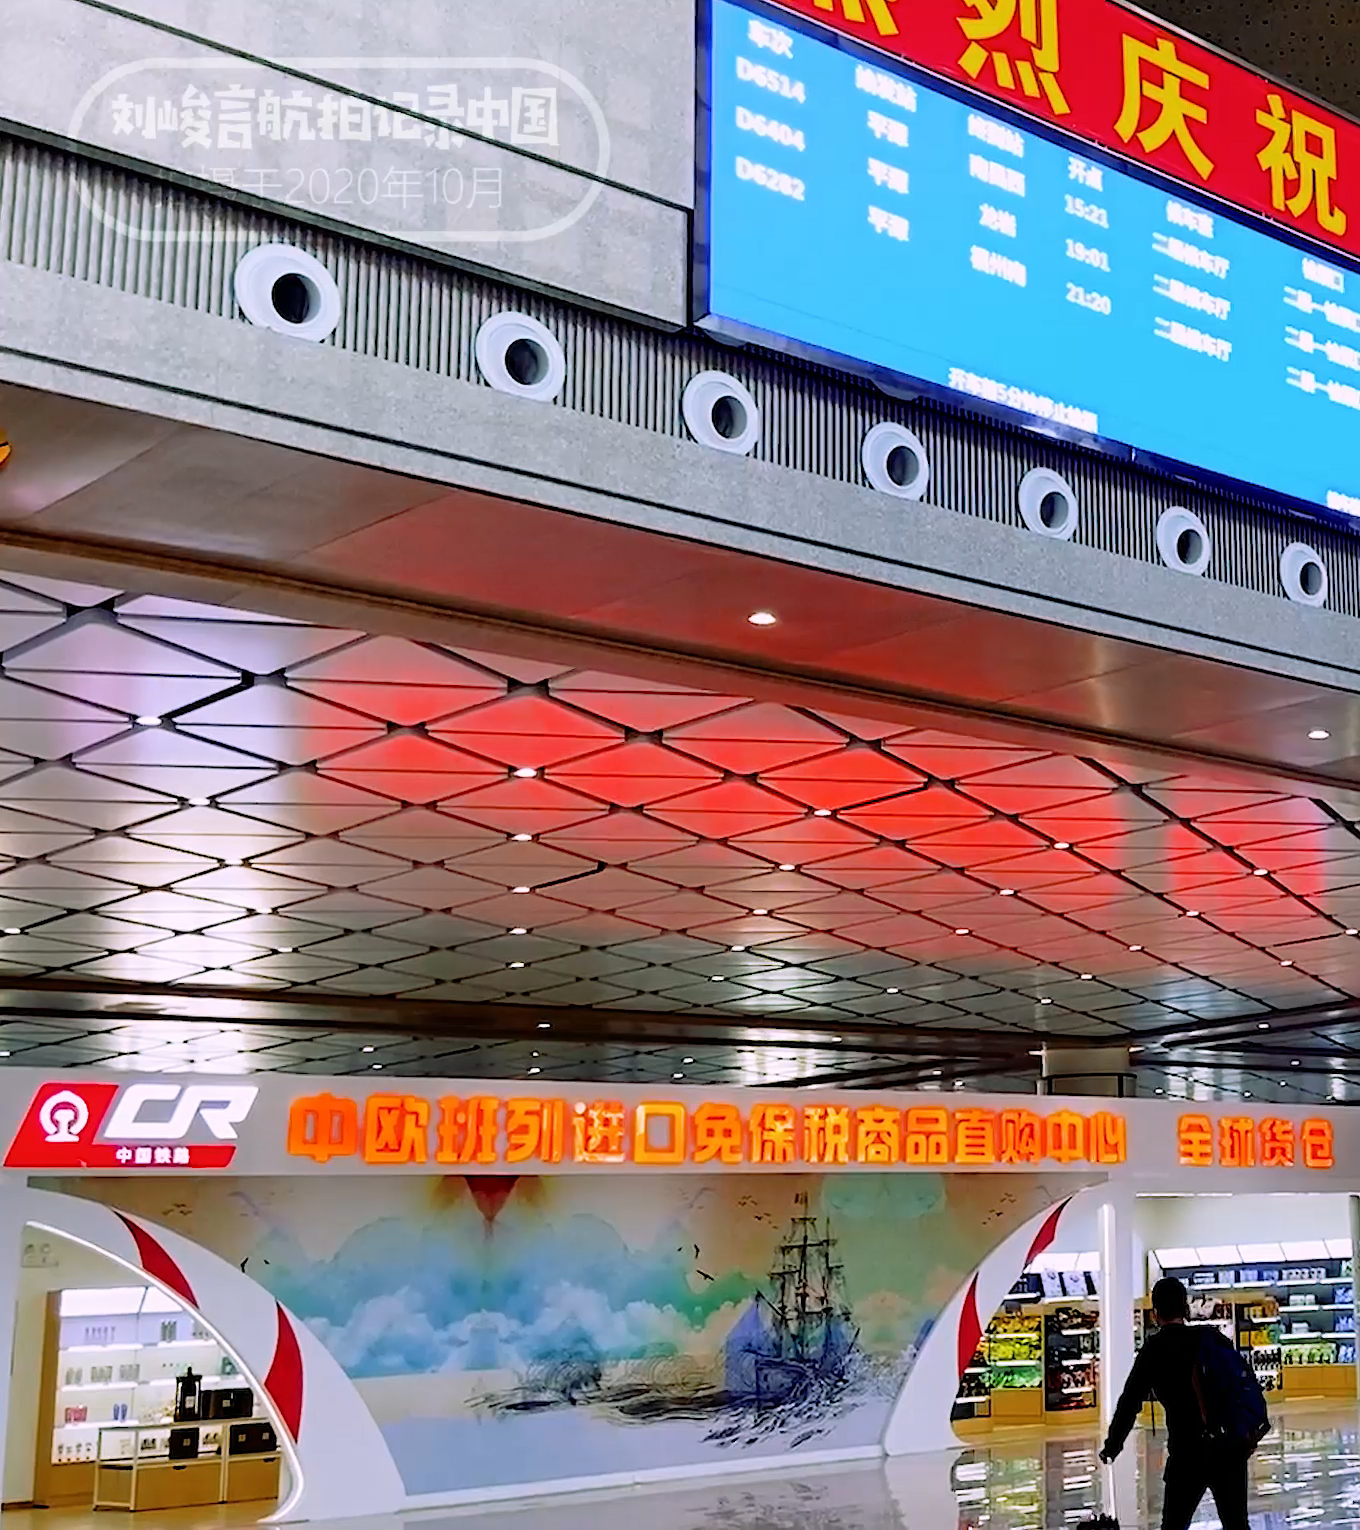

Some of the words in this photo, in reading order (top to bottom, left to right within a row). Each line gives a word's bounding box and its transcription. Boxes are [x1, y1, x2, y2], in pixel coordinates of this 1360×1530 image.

[1064, 195, 1110, 229] 15:21
[1064, 239, 1111, 272] 19:01
[1065, 282, 1112, 315] 21:20
[103, 1083, 259, 1139] CR
[286, 1091, 1128, 1166] 中欧班列进口免保税商品直购中心
[1177, 1113, 1334, 1168] 全球货仓
[115, 1146, 190, 1164] 中国铁路
